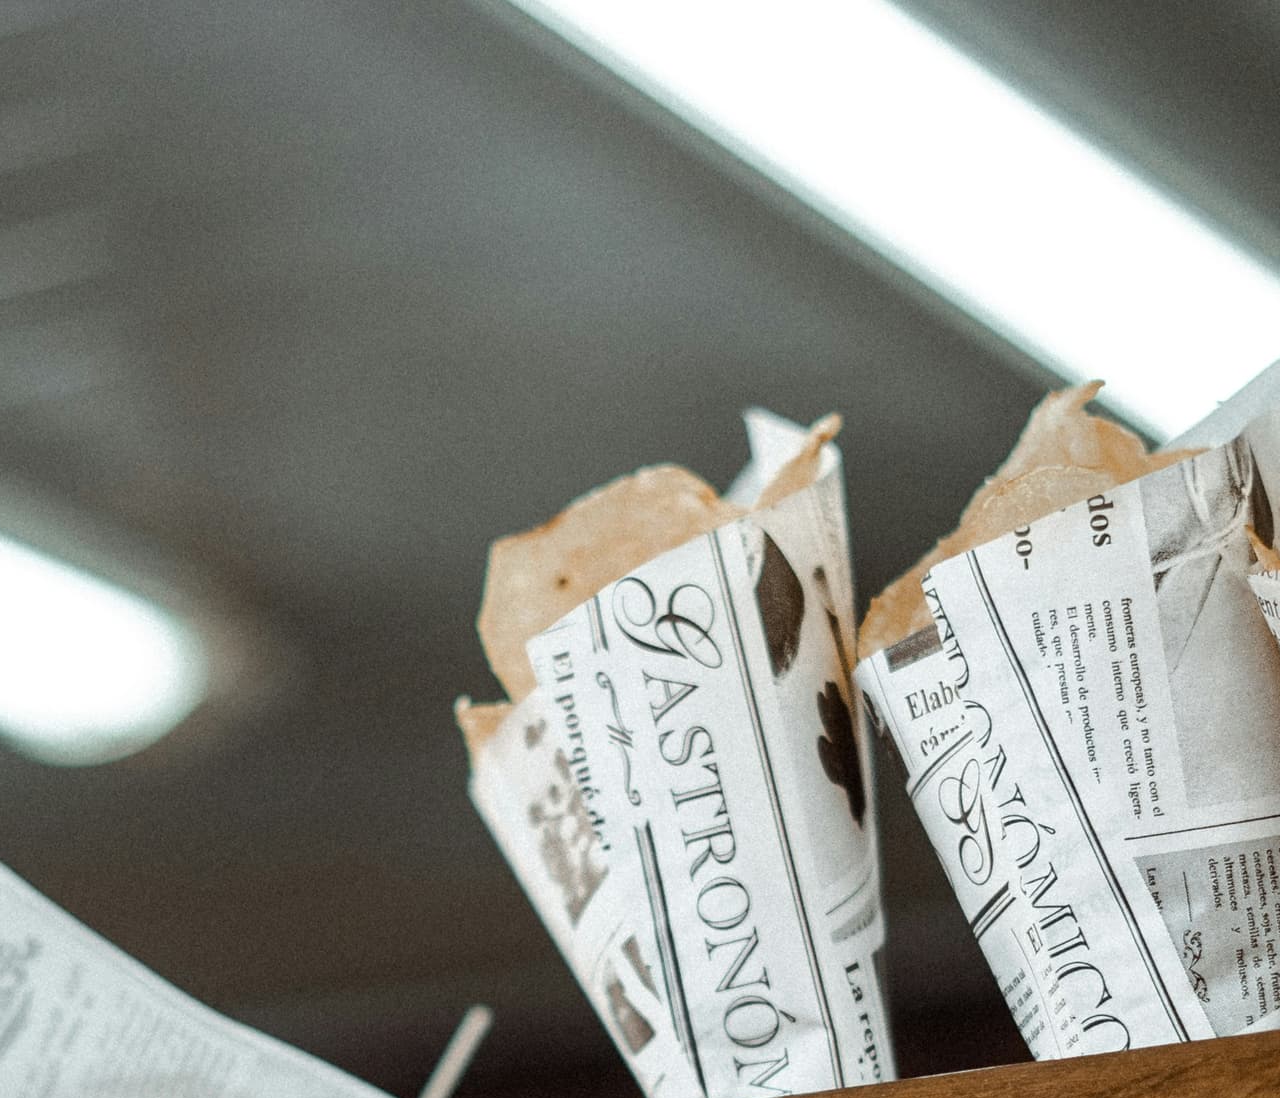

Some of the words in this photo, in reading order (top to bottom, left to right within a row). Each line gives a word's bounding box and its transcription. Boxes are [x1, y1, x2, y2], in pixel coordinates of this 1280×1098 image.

[1086, 493, 1116, 547] dos
[1048, 607, 1060, 629] res,
[1065, 605, 1078, 619] El
[1083, 602, 1098, 640] mente.
[1101, 599, 1118, 652] consumo
[1119, 596, 1137, 648] fronteras
[1049, 635, 1064, 657] que
[1068, 623, 1087, 682] desarrollo
[551, 650, 575, 683] El
[1054, 662, 1071, 705] prestan
[1110, 659, 1126, 702] interno
[1127, 651, 1147, 712] europeas),
[1076, 685, 1089, 701] de
[1078, 705, 1098, 762] productos
[1115, 708, 1130, 731] que
[1140, 727, 1150, 743] no
[553, 692, 600, 803] porqué
[1122, 737, 1138, 774] creció
[1142, 746, 1156, 776] tanto
[1126, 781, 1144, 820] ligera-
[1148, 780, 1160, 802] con
[1151, 805, 1165, 817] el
[1207, 857, 1225, 910] derivados.
[1237, 853, 1252, 899] mostaza,
[1252, 850, 1269, 910] cacahuetes,
[1222, 855, 1239, 912] altramuces
[1234, 948, 1250, 998] moluscos,
[1245, 906, 1259, 949] semillas
[1259, 912, 1272, 937] soja,
[1251, 955, 1262, 968] de
[1264, 938, 1278, 969] leche,
[843, 960, 867, 1003] La
